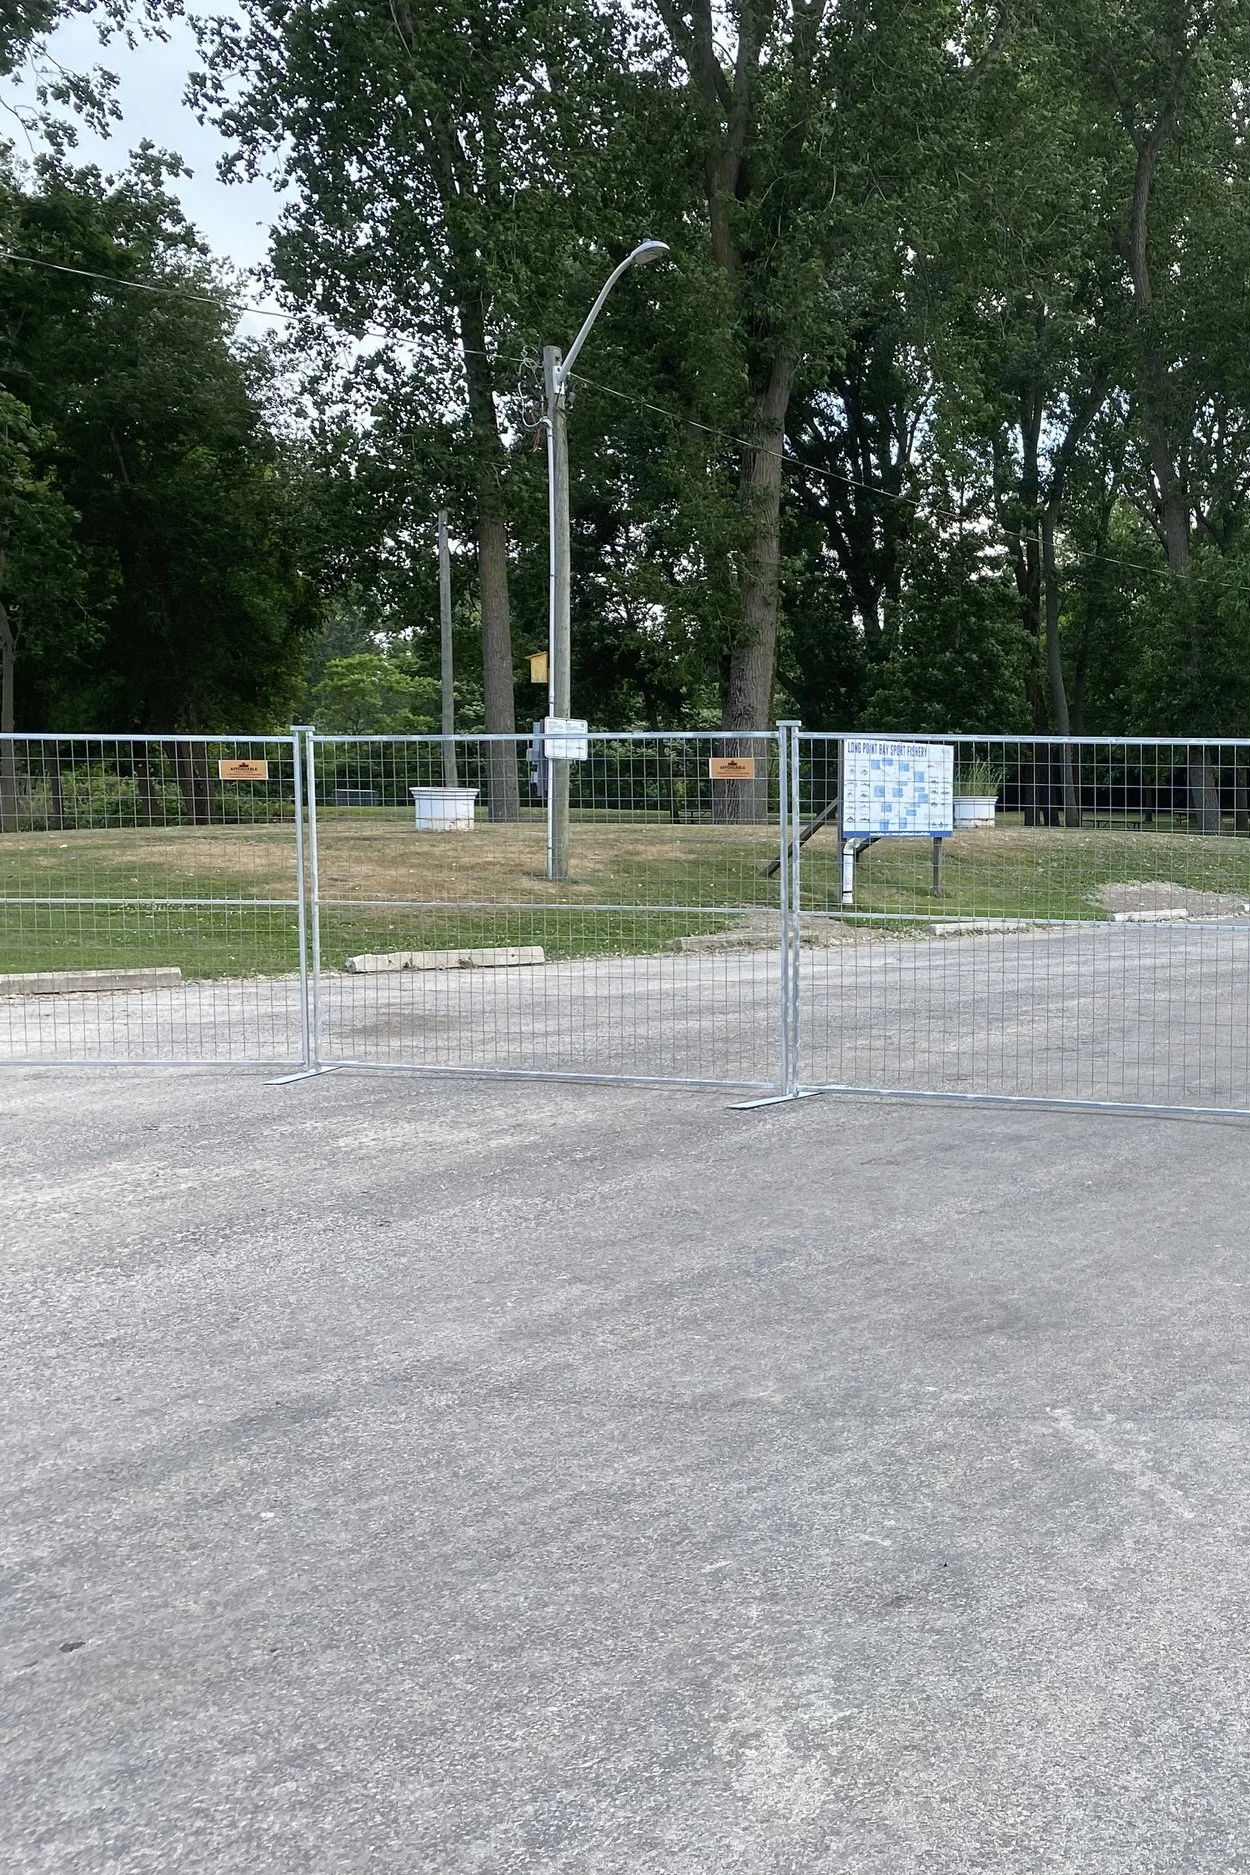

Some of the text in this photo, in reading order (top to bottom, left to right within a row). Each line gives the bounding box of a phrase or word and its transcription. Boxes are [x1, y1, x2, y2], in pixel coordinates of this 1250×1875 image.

[848, 741, 927, 757] LONG POINT BAY SPORT FISHERY
